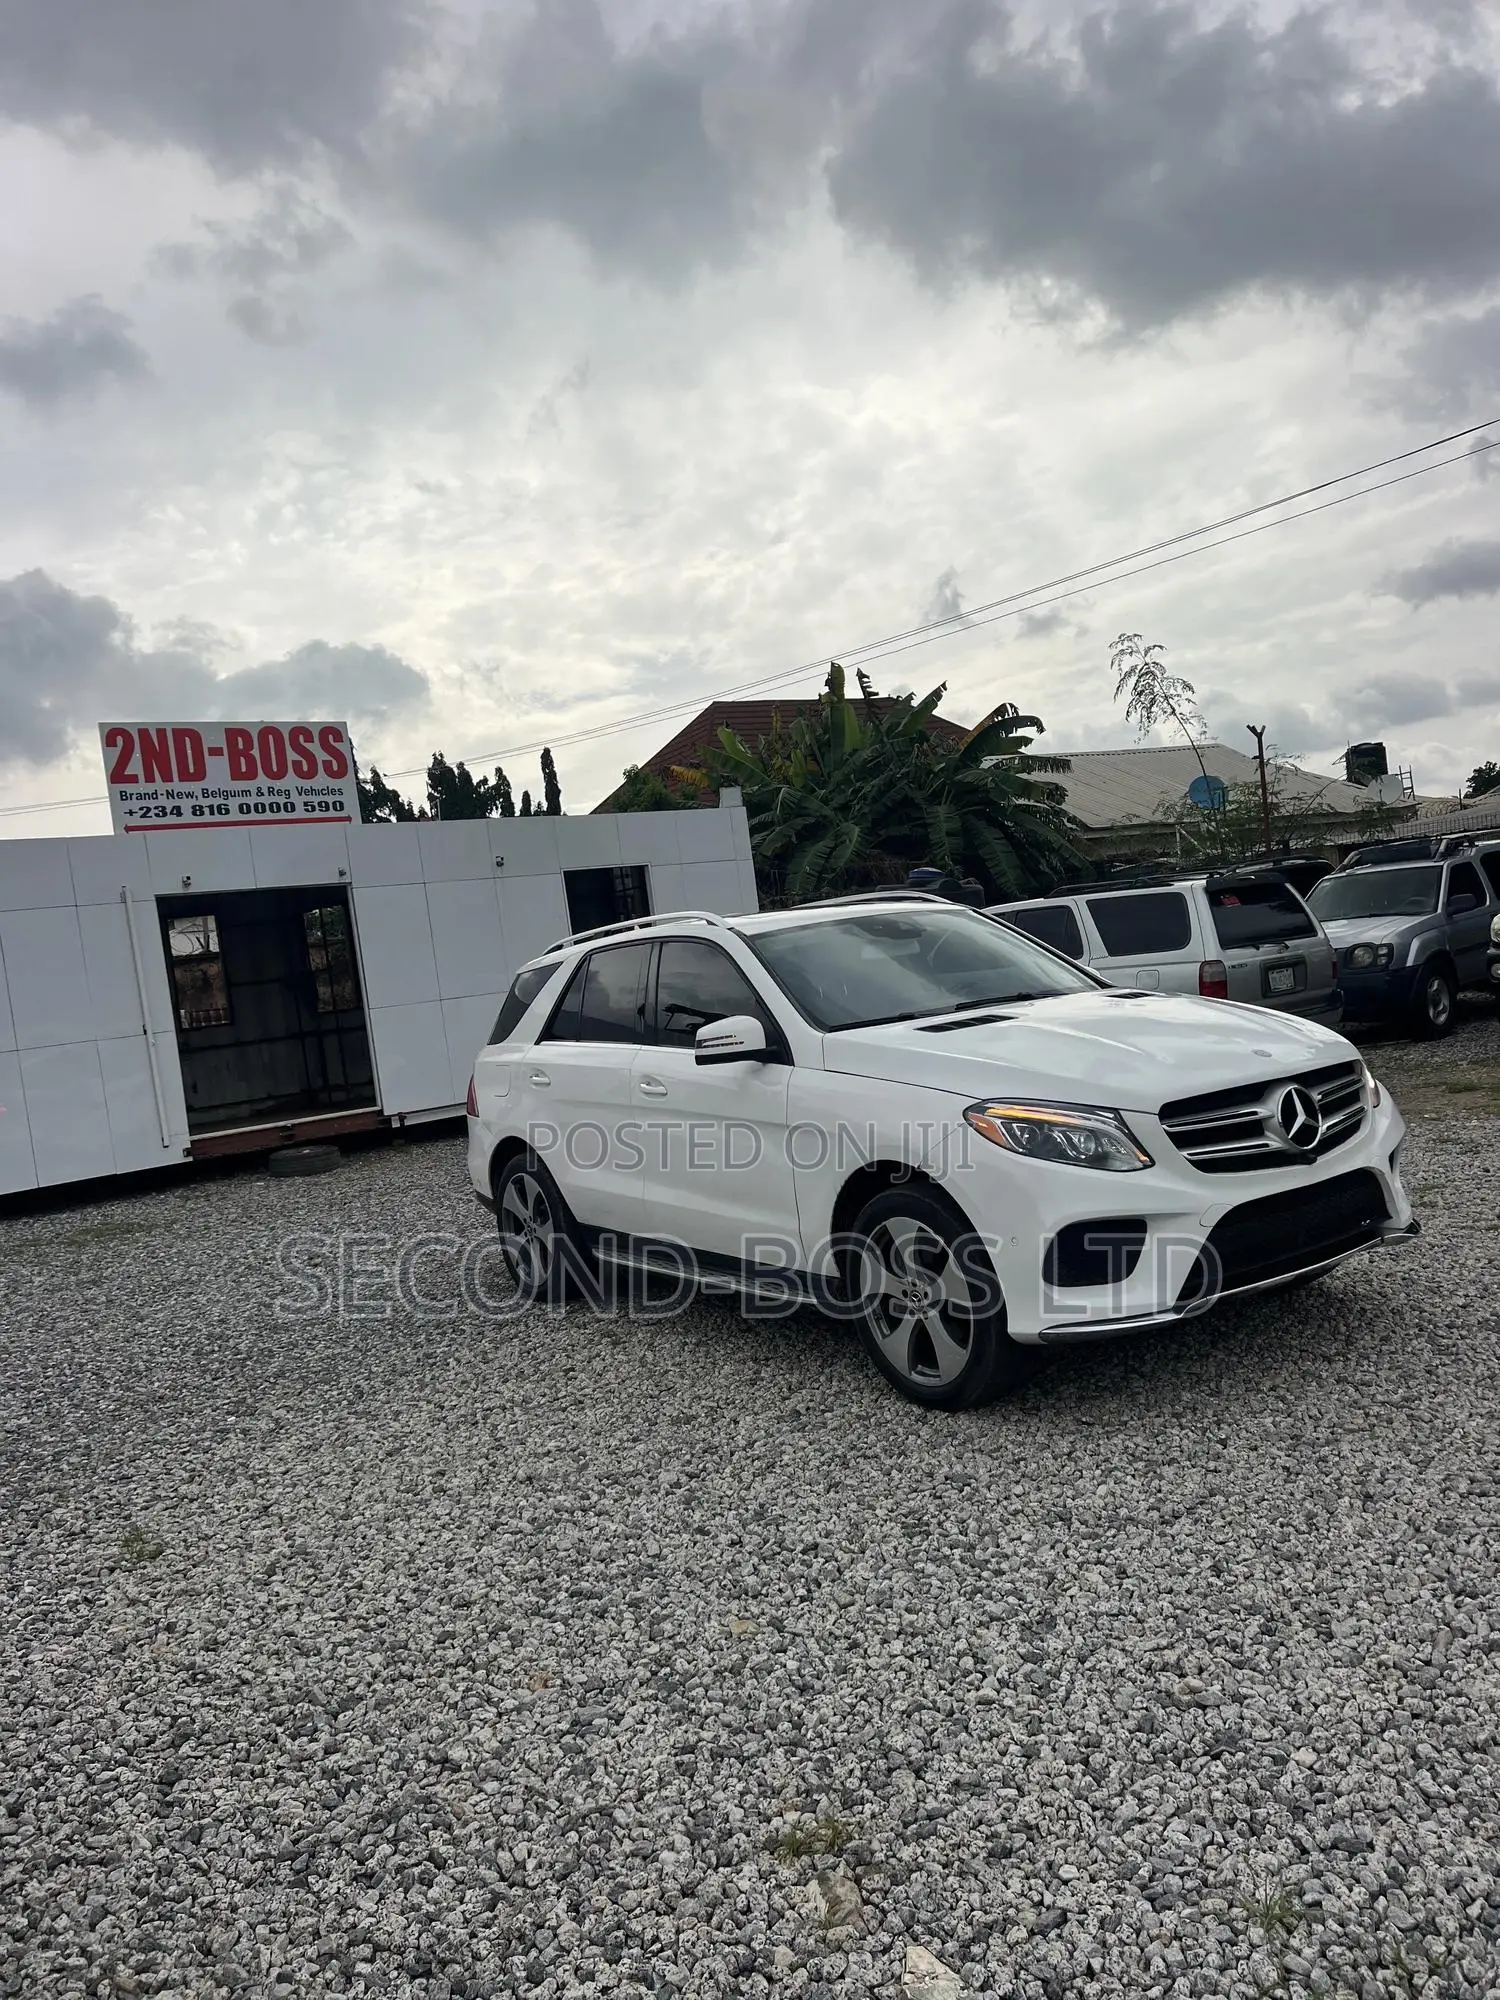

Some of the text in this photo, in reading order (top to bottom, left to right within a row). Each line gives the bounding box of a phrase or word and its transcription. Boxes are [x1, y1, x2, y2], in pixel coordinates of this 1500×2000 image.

[104, 725, 349, 784] 2ND-BOSS
[119, 785, 344, 802] Brand-New, Belguim & Reg Vehicles
[123, 800, 345, 819] +234 816 0000 590
